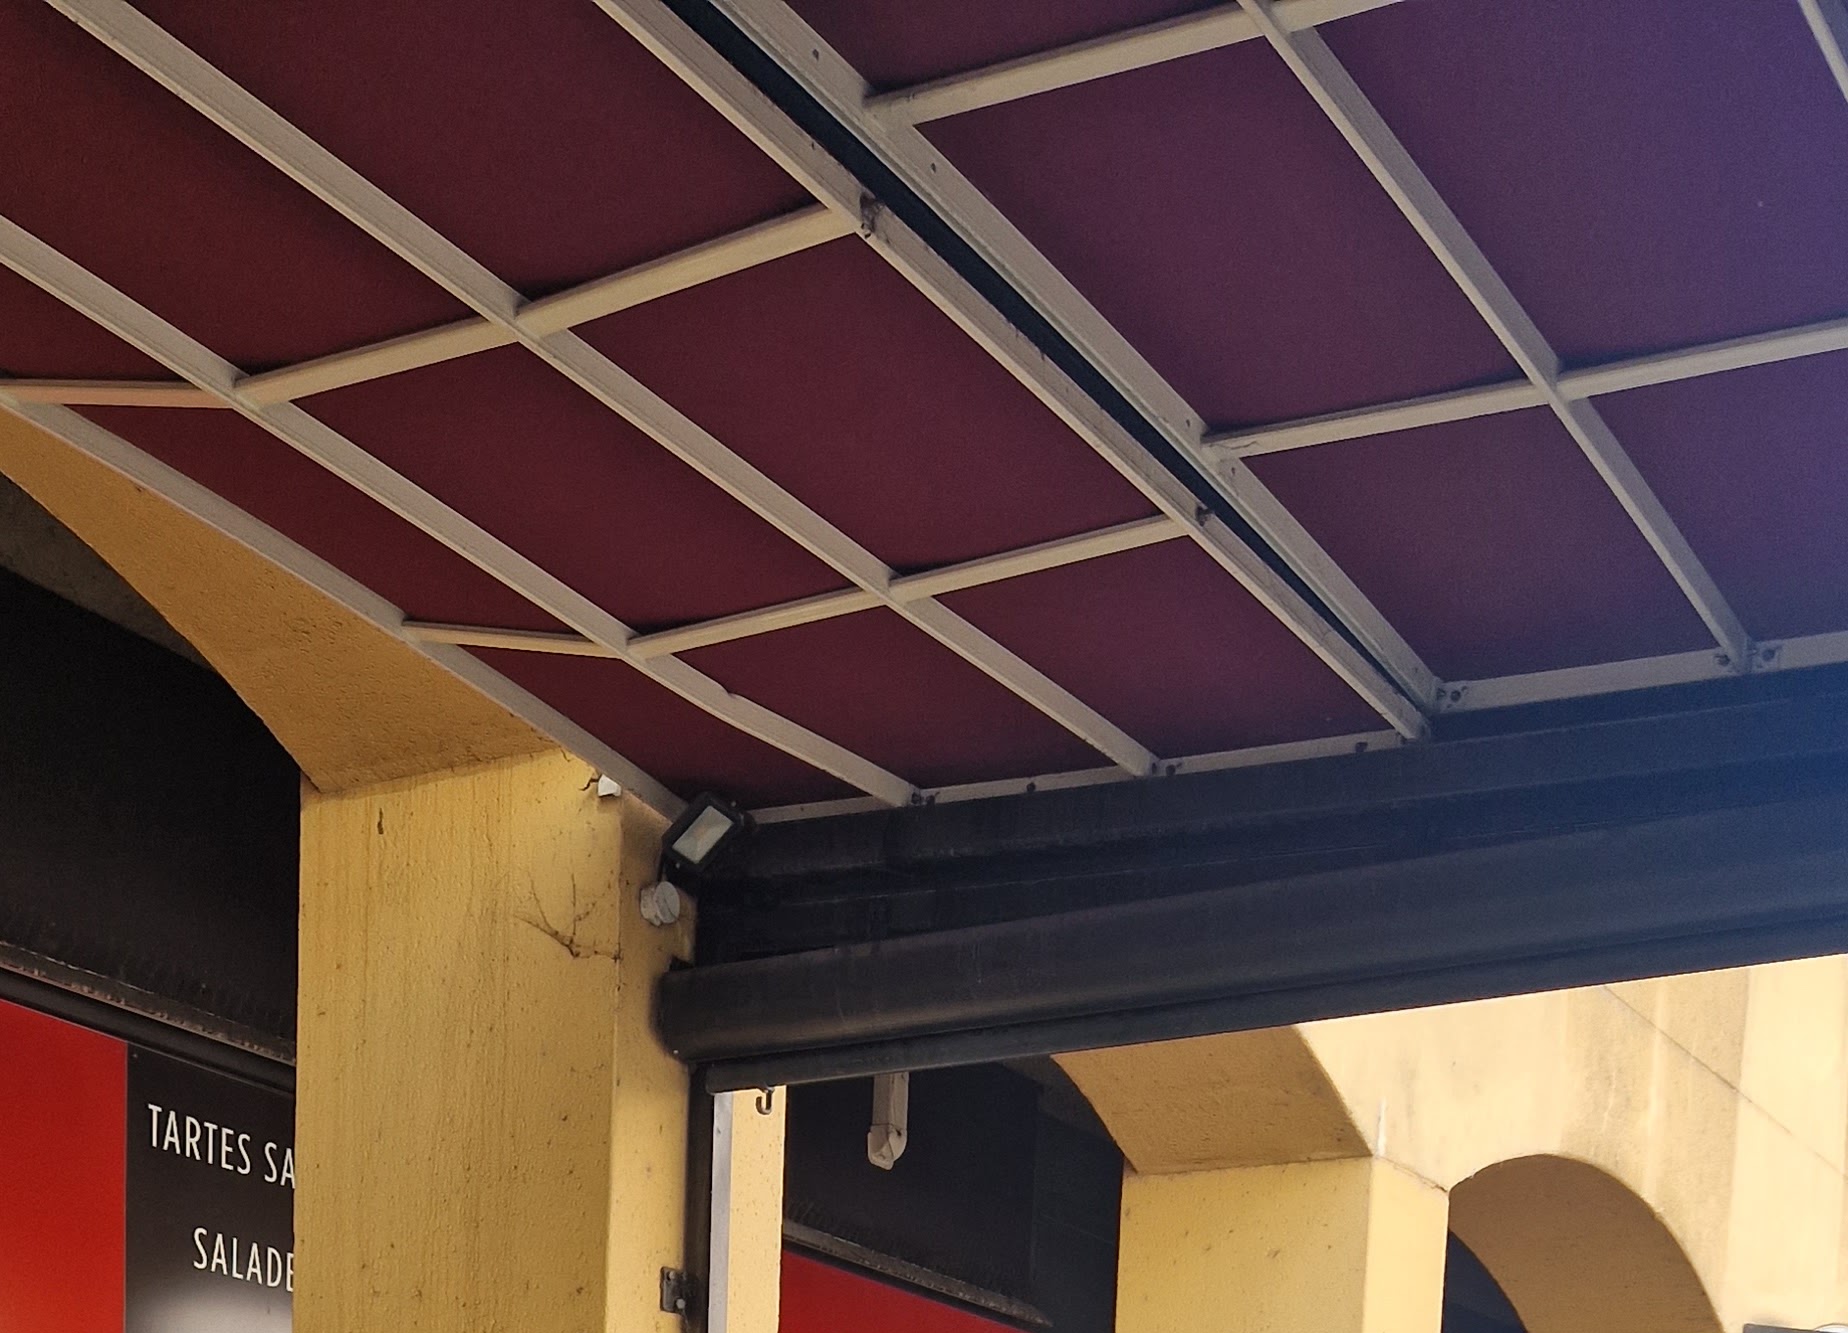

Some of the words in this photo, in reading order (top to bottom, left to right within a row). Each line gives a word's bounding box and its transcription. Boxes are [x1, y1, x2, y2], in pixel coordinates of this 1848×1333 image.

[147, 1103, 251, 1175] TARTES
[263, 1142, 295, 1189] SA
[193, 1227, 294, 1293] SALADE
